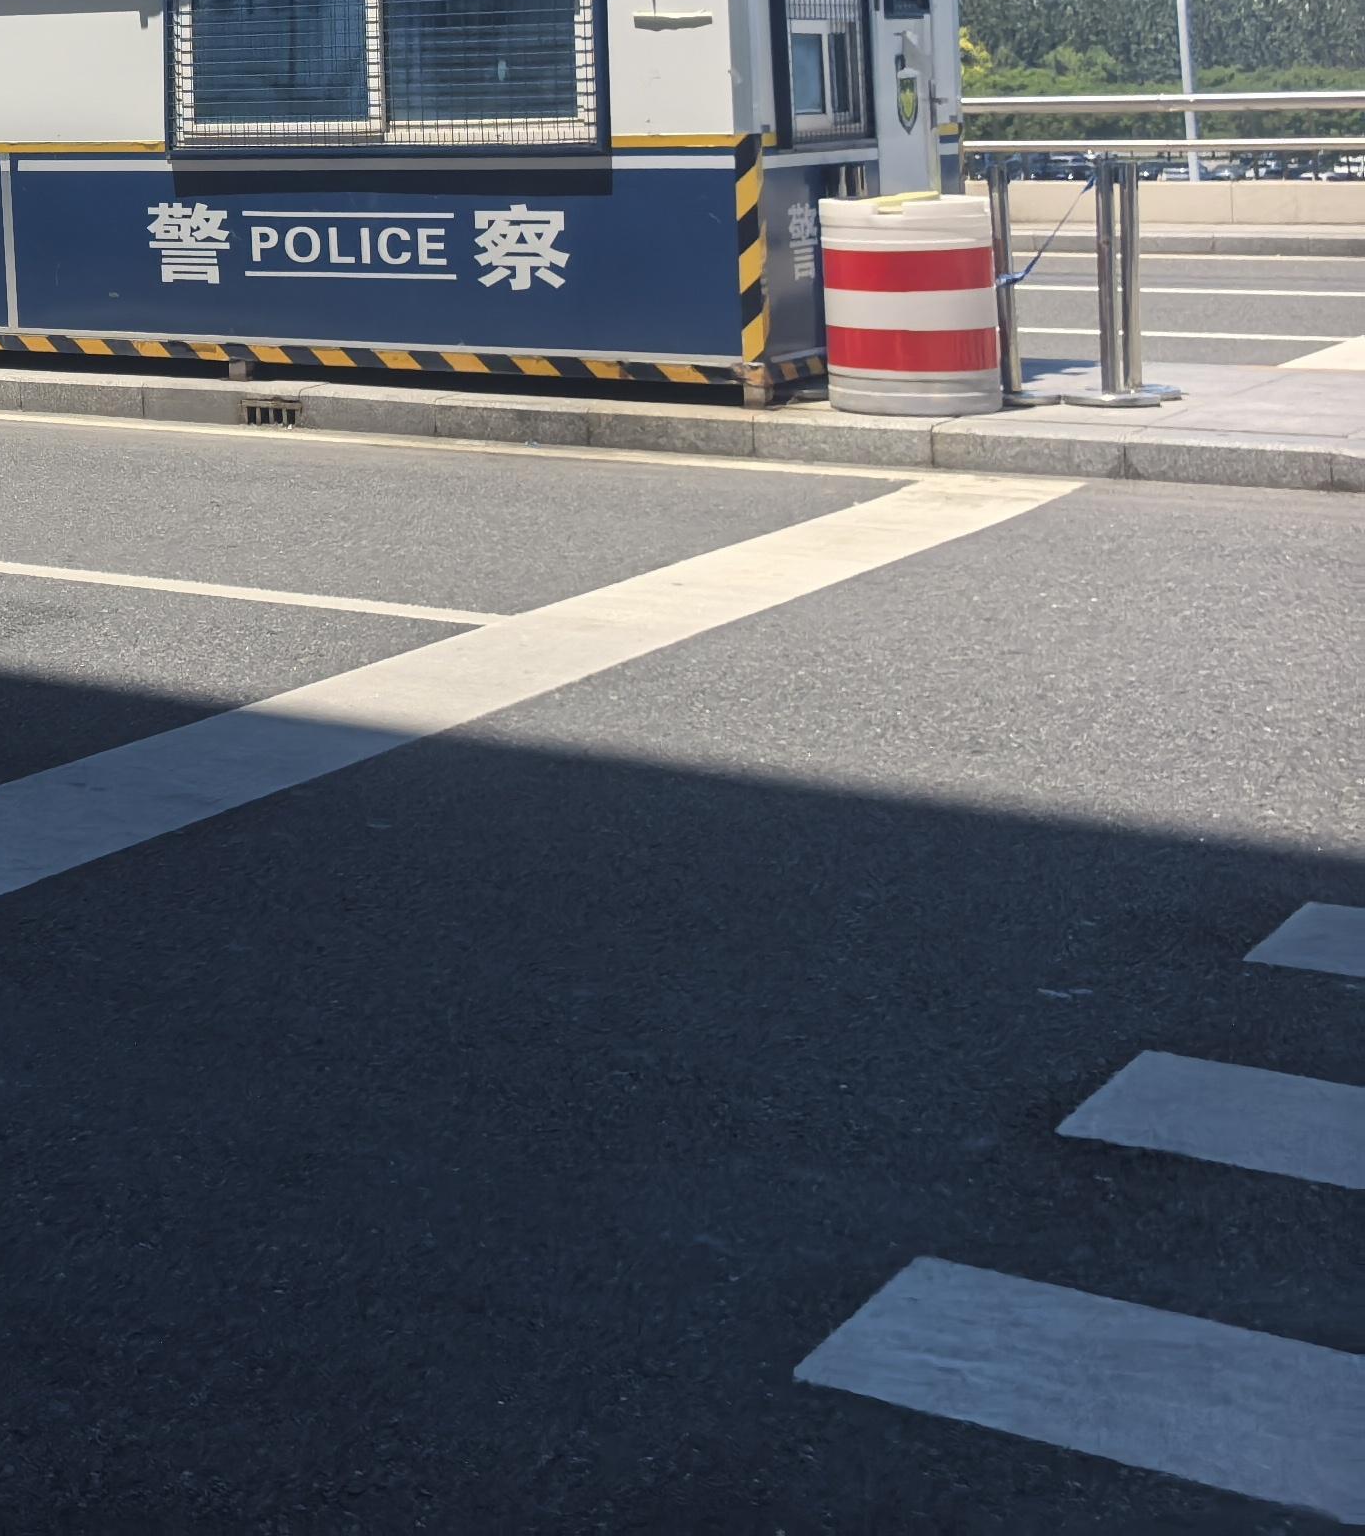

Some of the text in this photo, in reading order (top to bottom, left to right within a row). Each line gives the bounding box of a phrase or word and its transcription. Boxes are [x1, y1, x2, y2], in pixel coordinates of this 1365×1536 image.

[147, 202, 570, 291] 警 POLICE 察
[788, 203, 818, 282] 警
